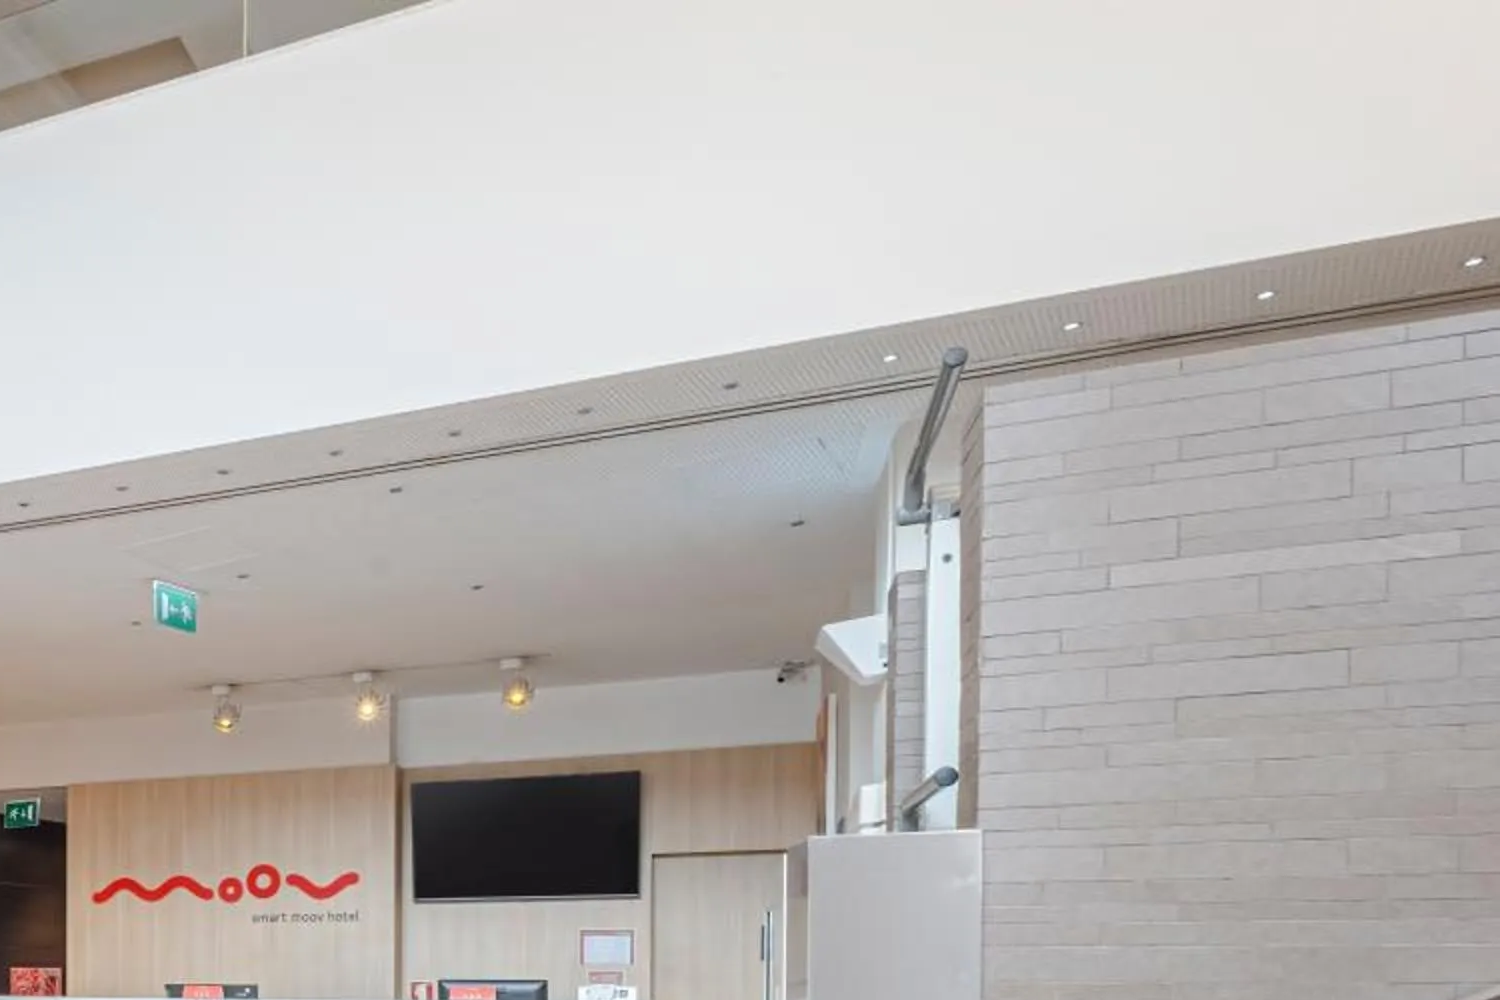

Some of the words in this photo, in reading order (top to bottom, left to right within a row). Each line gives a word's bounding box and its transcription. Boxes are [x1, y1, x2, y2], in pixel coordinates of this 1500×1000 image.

[252, 912, 287, 923] smart
[291, 912, 324, 923] moov
[327, 909, 359, 922] hotel
